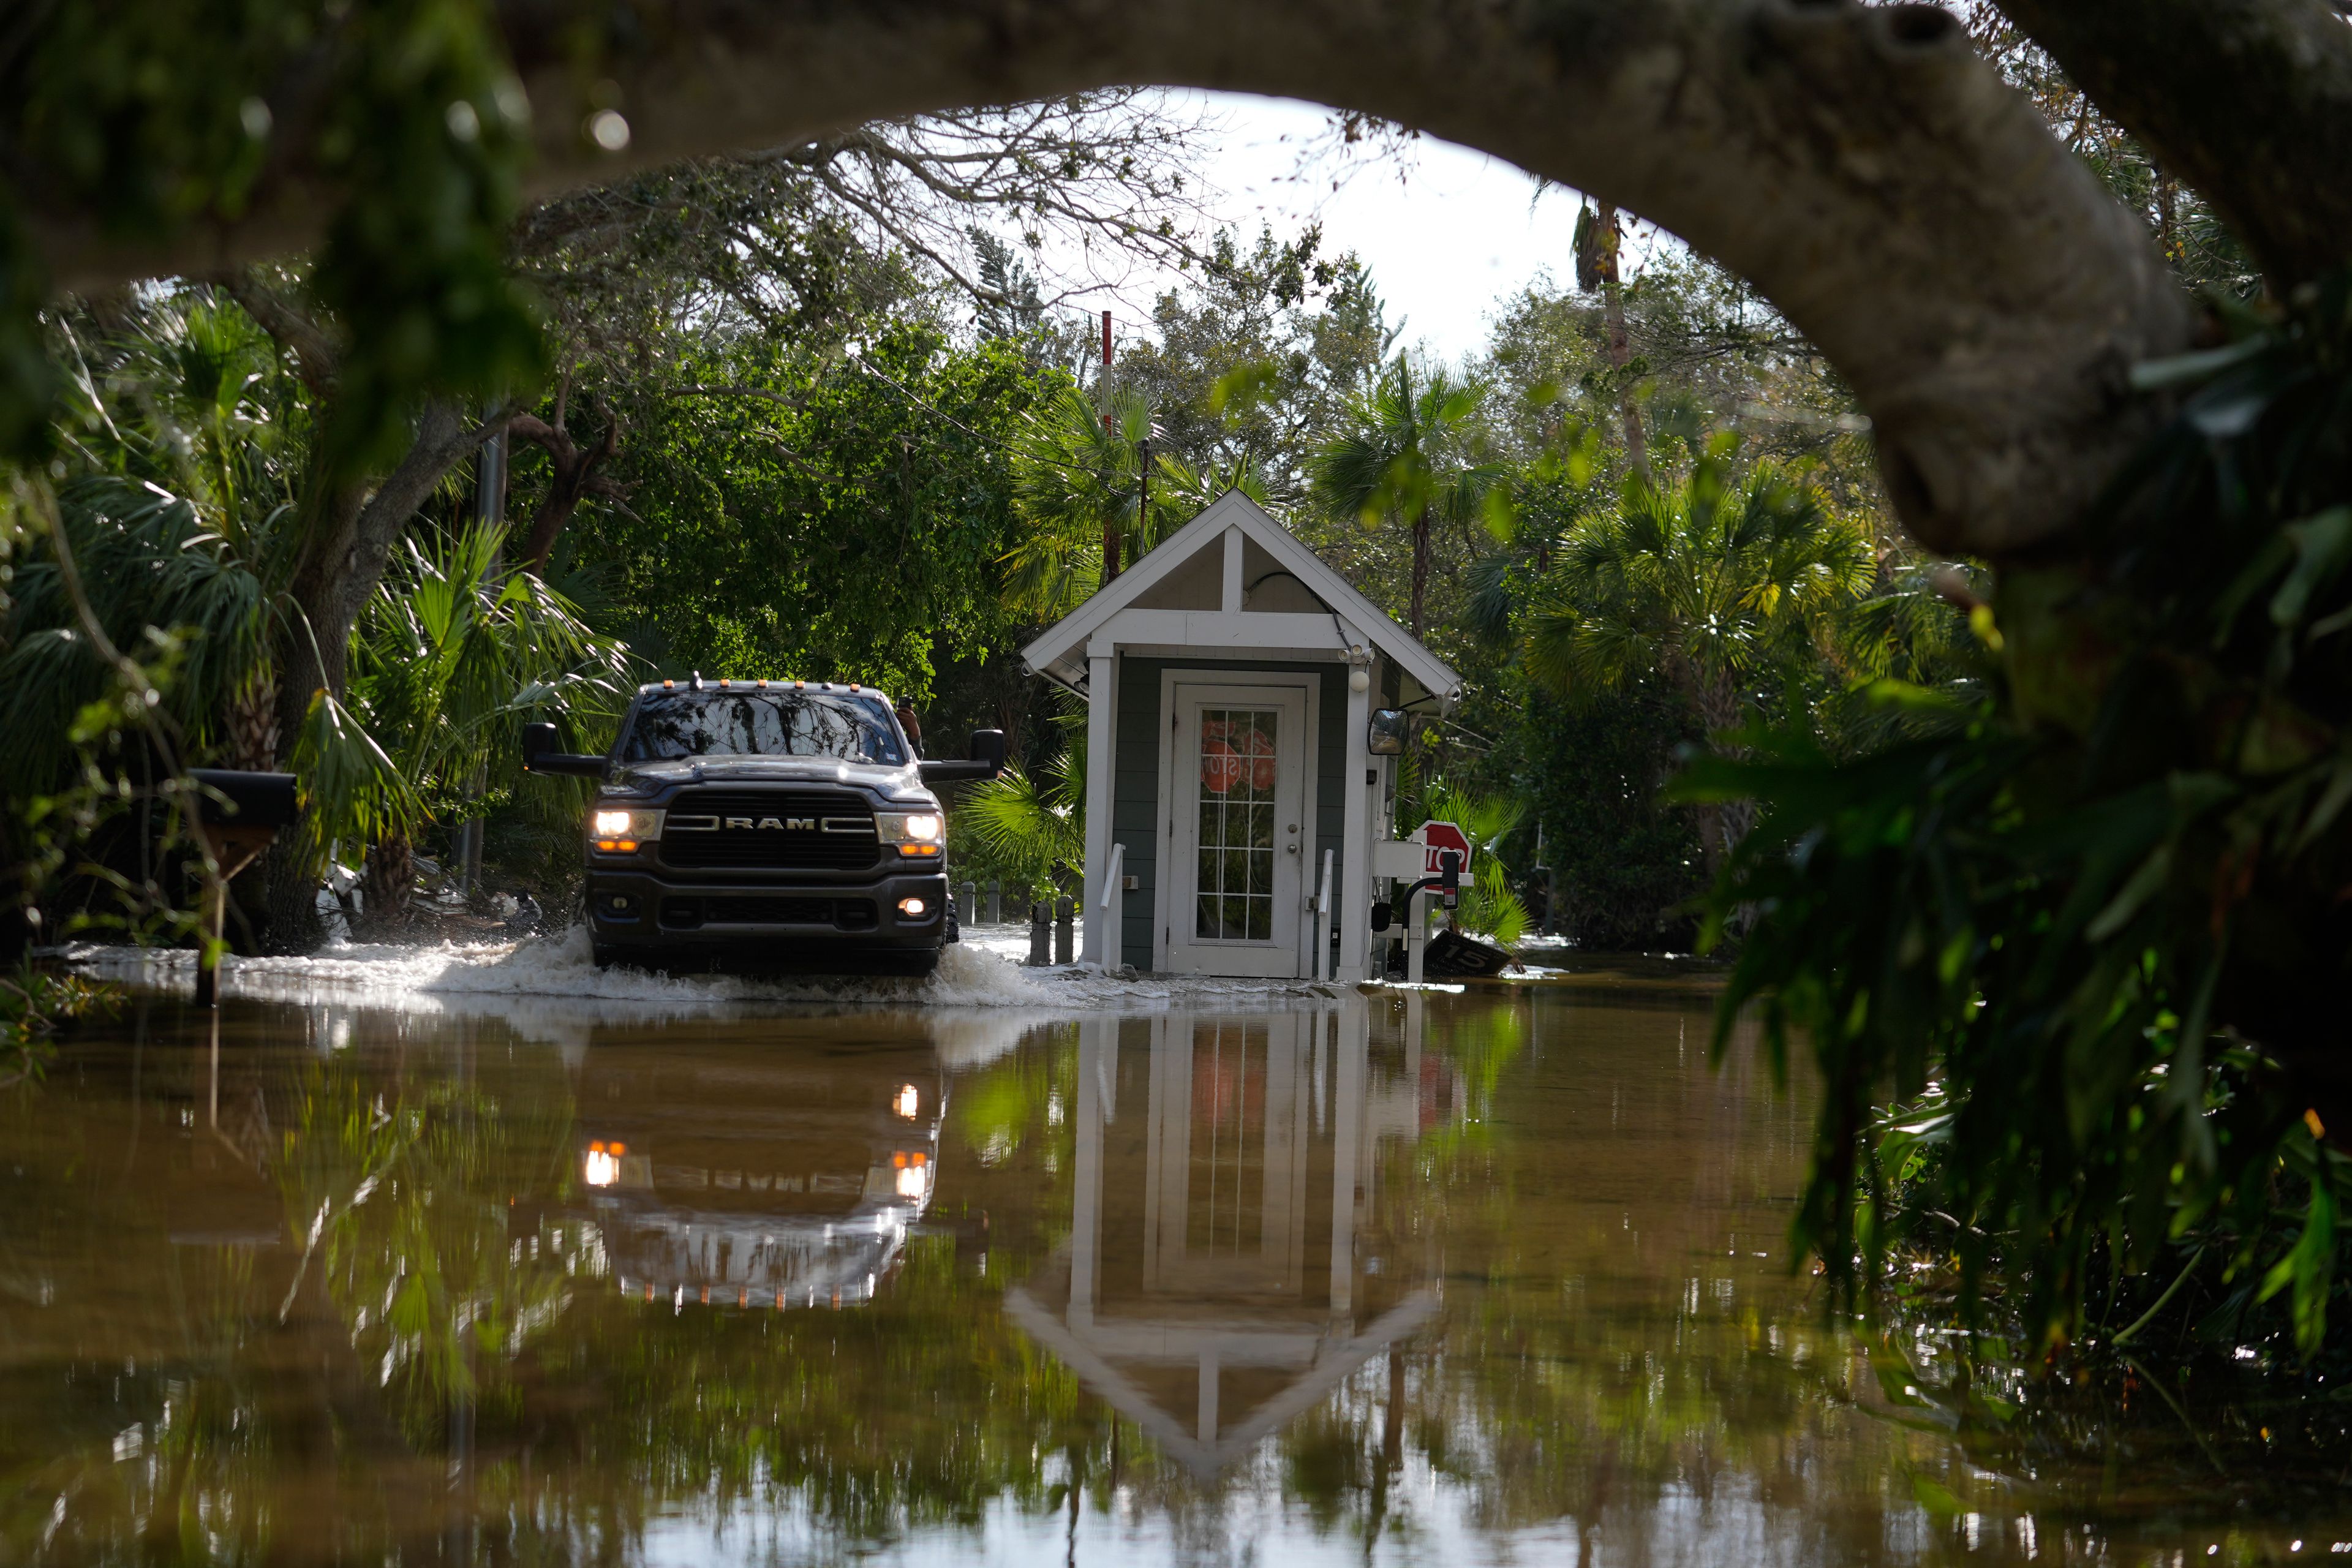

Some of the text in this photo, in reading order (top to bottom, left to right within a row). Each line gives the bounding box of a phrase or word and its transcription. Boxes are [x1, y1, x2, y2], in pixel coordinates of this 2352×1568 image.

[725, 817, 815, 830] RAM
[1427, 845, 1466, 870] TOP
[1445, 944, 1489, 968] 15
